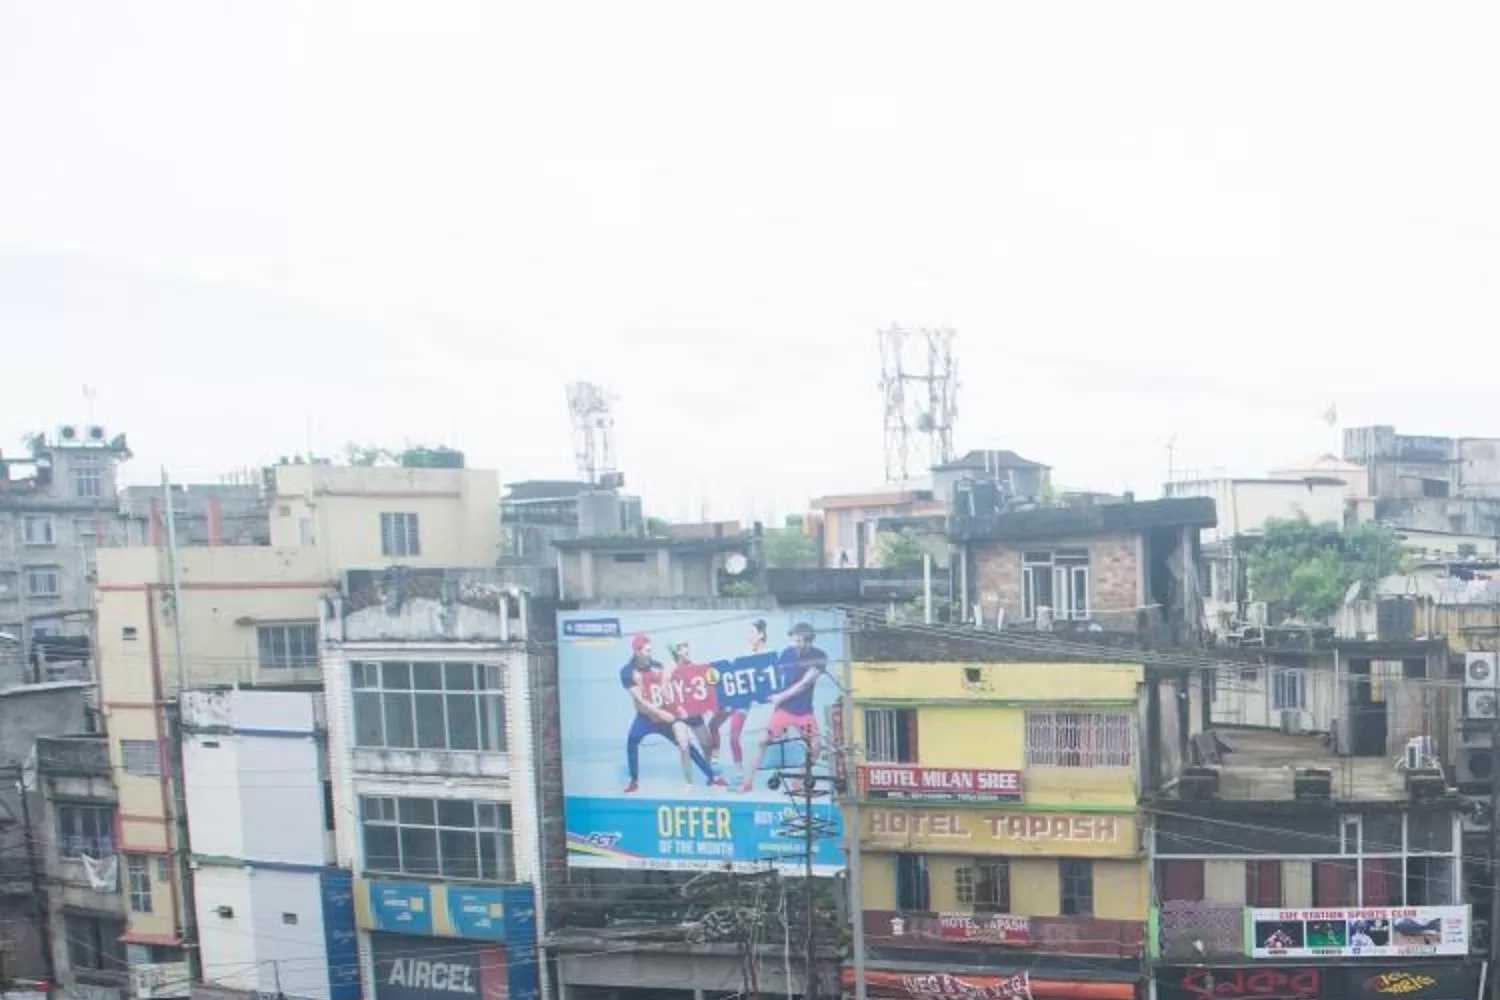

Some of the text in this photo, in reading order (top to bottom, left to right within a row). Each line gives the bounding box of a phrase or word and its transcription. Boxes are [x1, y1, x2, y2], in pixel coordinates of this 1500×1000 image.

[869, 768, 1018, 791] HOTEL MILAN SREE
[657, 806, 732, 839] OFFER
[868, 811, 1118, 843] HOTEL TAPASH
[388, 957, 477, 994] AIRCEL
